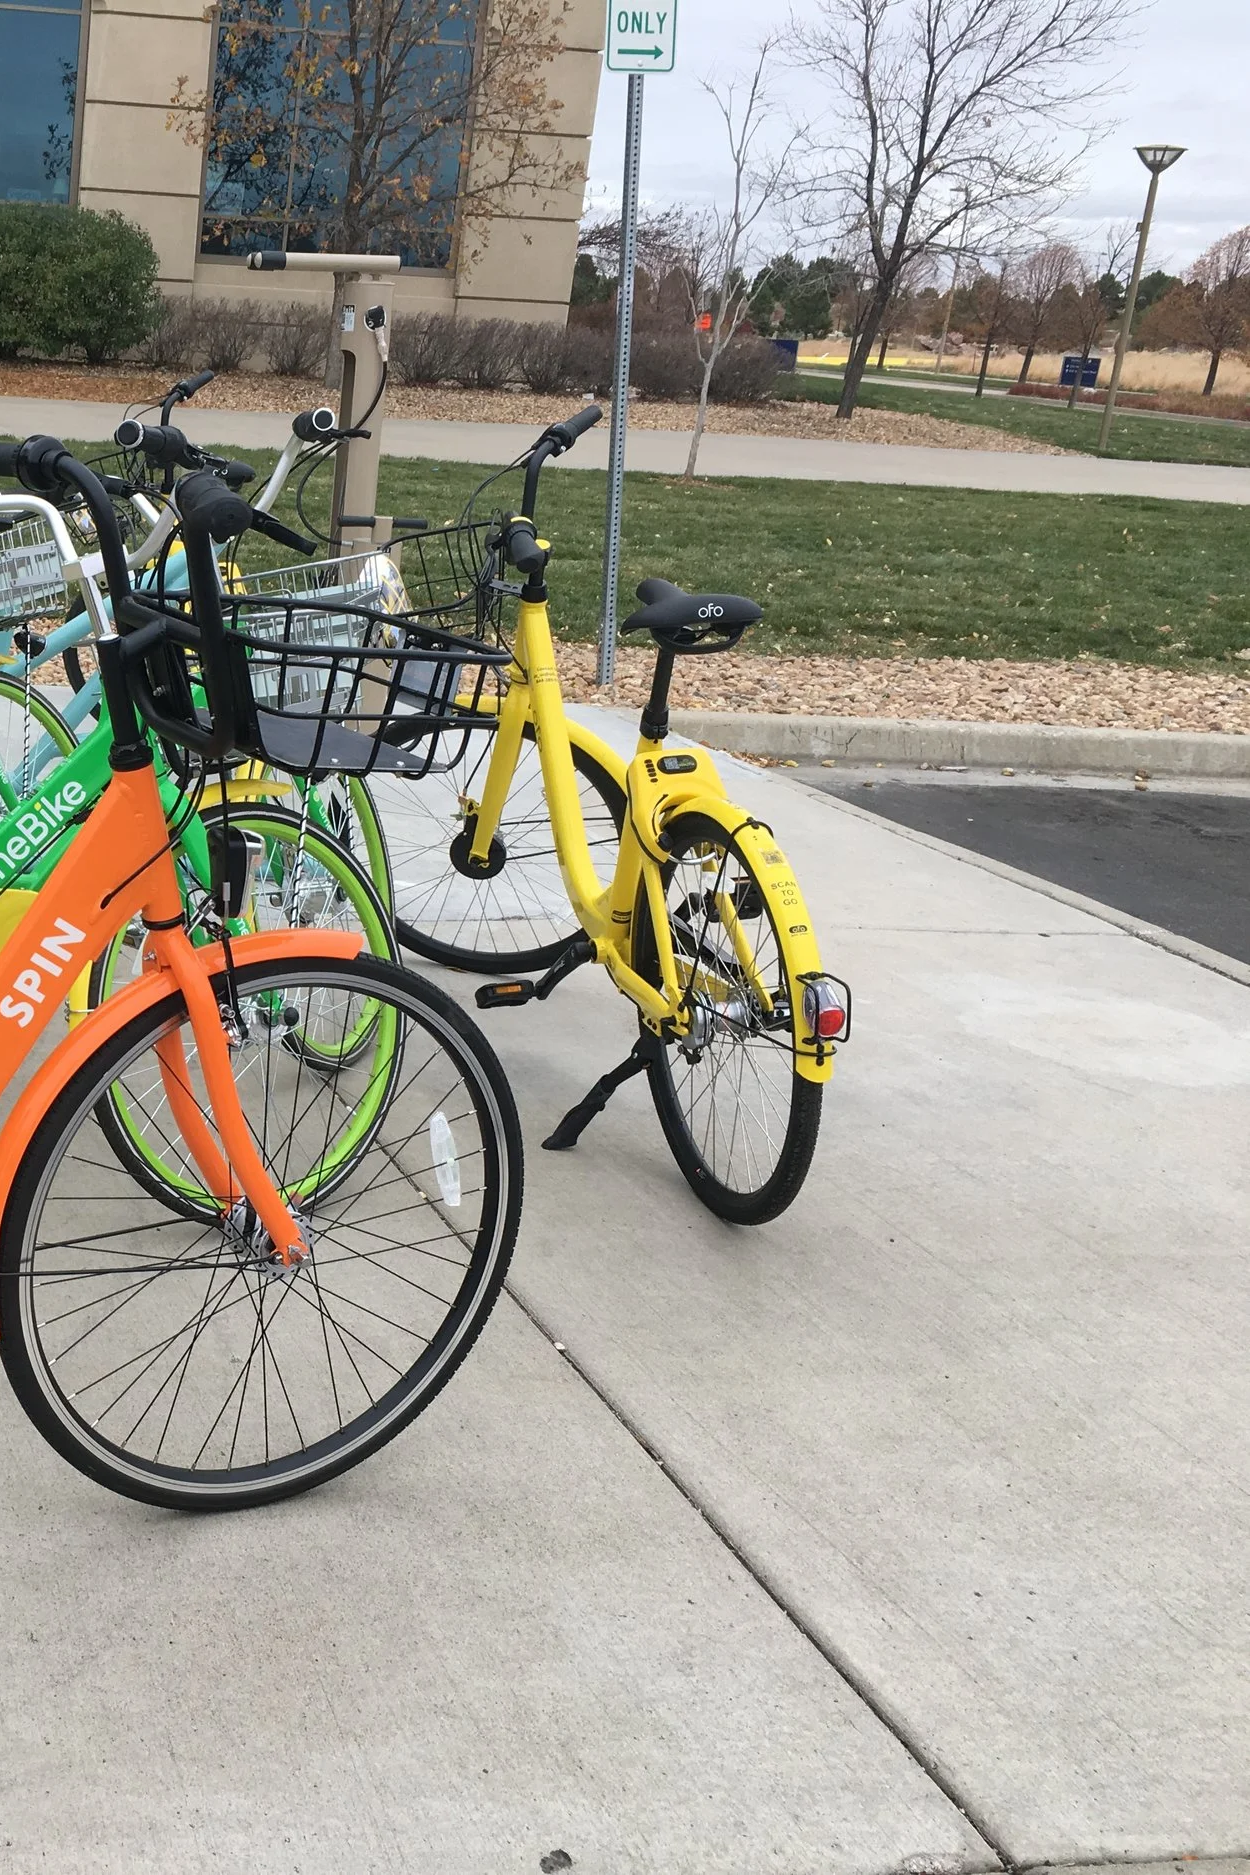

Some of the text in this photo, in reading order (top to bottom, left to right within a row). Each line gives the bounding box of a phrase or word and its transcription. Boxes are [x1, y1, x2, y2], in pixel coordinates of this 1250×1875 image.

[617, 11, 667, 34] ONLY
[698, 602, 724, 618] ofo
[783, 898, 798, 906] GO
